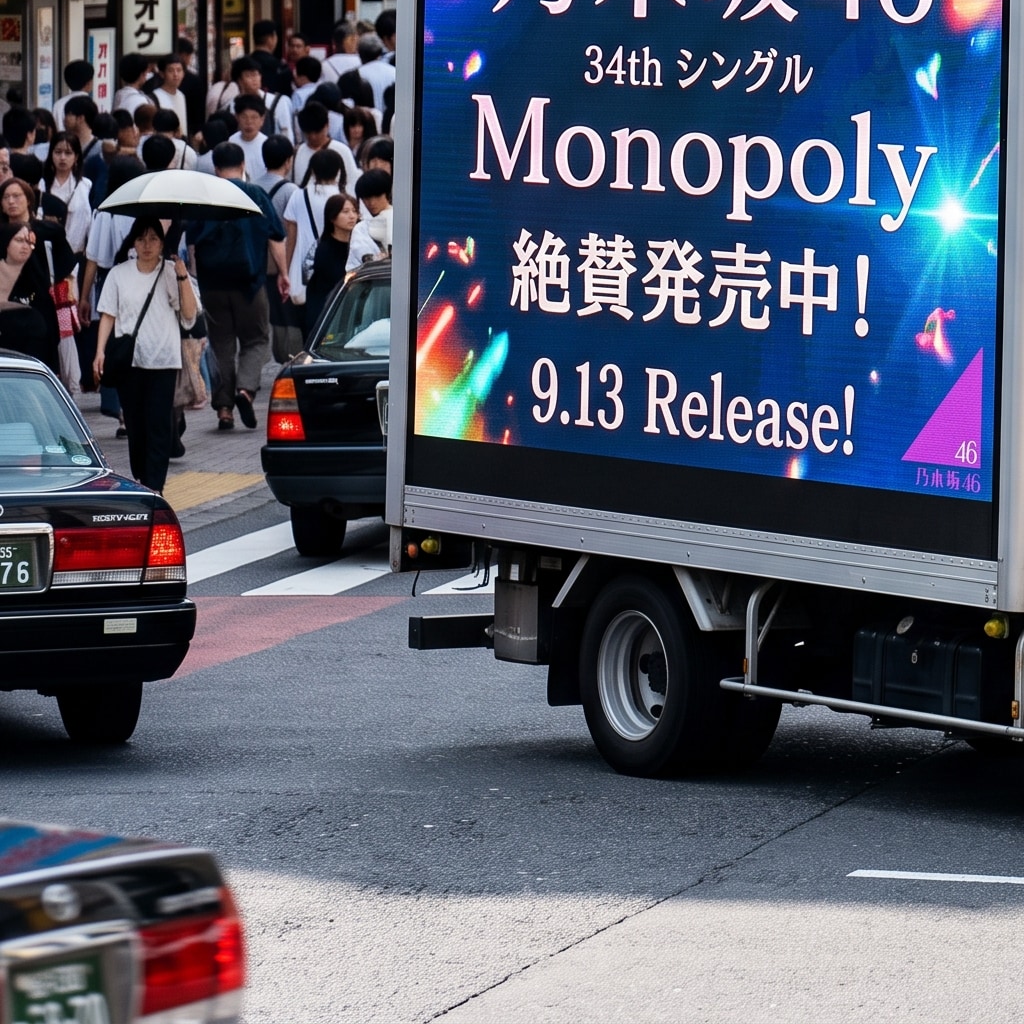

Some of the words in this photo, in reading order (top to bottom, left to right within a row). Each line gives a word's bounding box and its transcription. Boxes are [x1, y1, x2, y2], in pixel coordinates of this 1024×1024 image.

[583, 45, 663, 87] 34th
[677, 48, 814, 95] シングル
[469, 93, 939, 232] Monopoly
[530, 357, 625, 431] 9.13
[643, 367, 856, 456] Release!
[954, 440, 978, 465] 46
